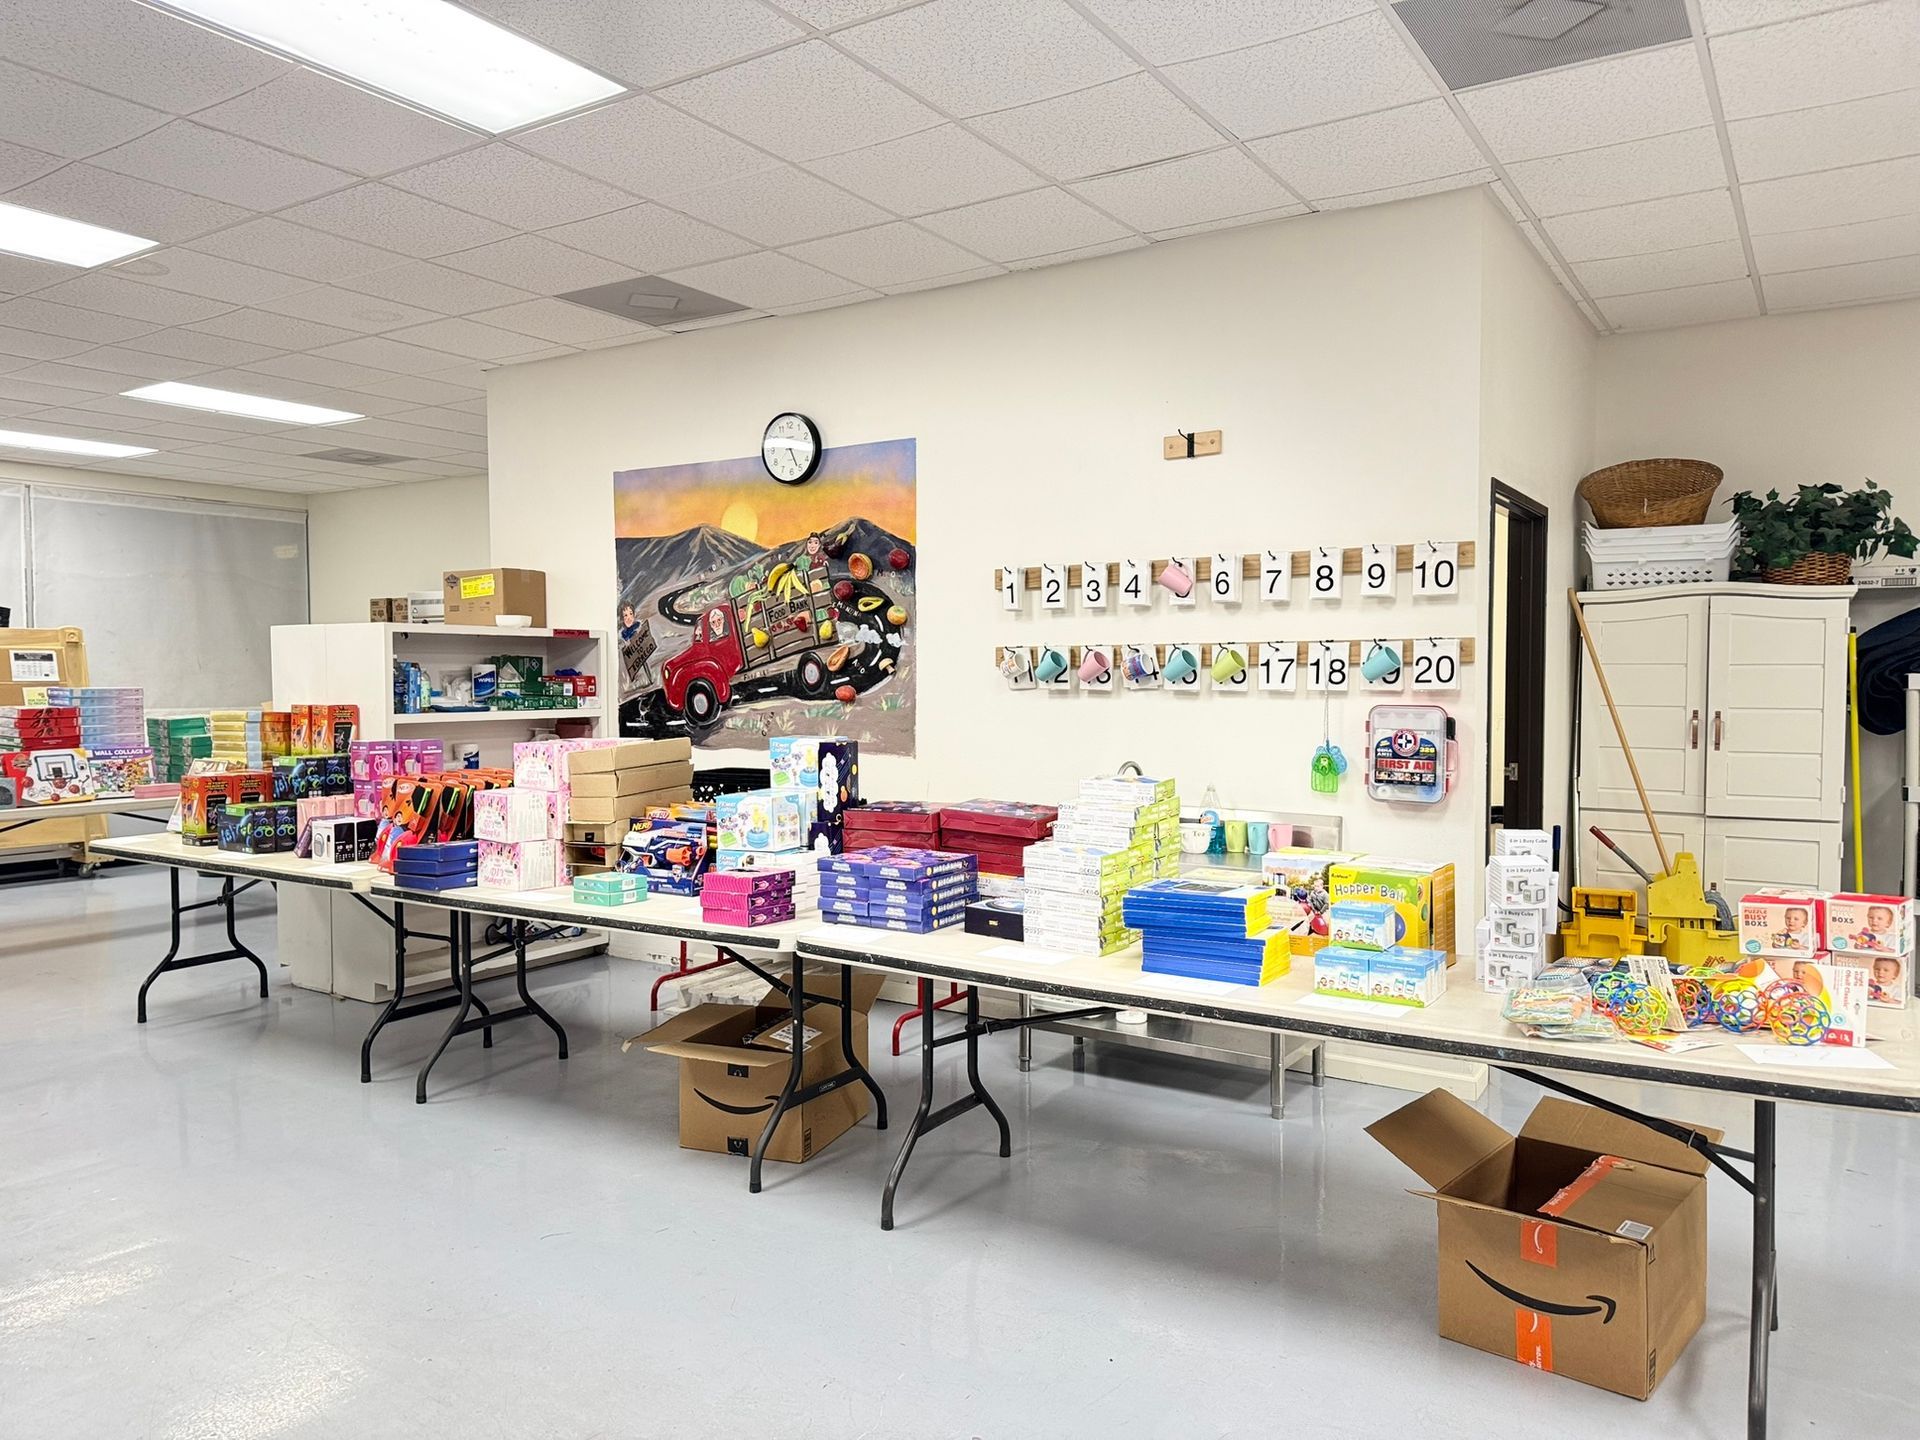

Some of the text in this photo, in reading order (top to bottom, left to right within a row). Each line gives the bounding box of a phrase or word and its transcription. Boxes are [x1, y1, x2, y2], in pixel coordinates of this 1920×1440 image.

[1124, 574, 1141, 599] 4
[1215, 570, 1230, 595] 6
[1266, 569, 1282, 594] 7
[1315, 564, 1334, 591] 8
[1367, 563, 1386, 589] 9
[1415, 560, 1455, 589] 10
[1006, 582, 1014, 604] 1
[1046, 579, 1061, 603] 2
[1086, 579, 1101, 602] 3
[1260, 658, 1295, 684] 17
[1309, 658, 1346, 685] 18
[1414, 655, 1455, 683] 20
[1377, 759, 1435, 771] FIRST AID
[632, 821, 650, 832] NERF
[1334, 884, 1404, 902] Hopper Ball
[1831, 916, 1855, 924] BOXS
